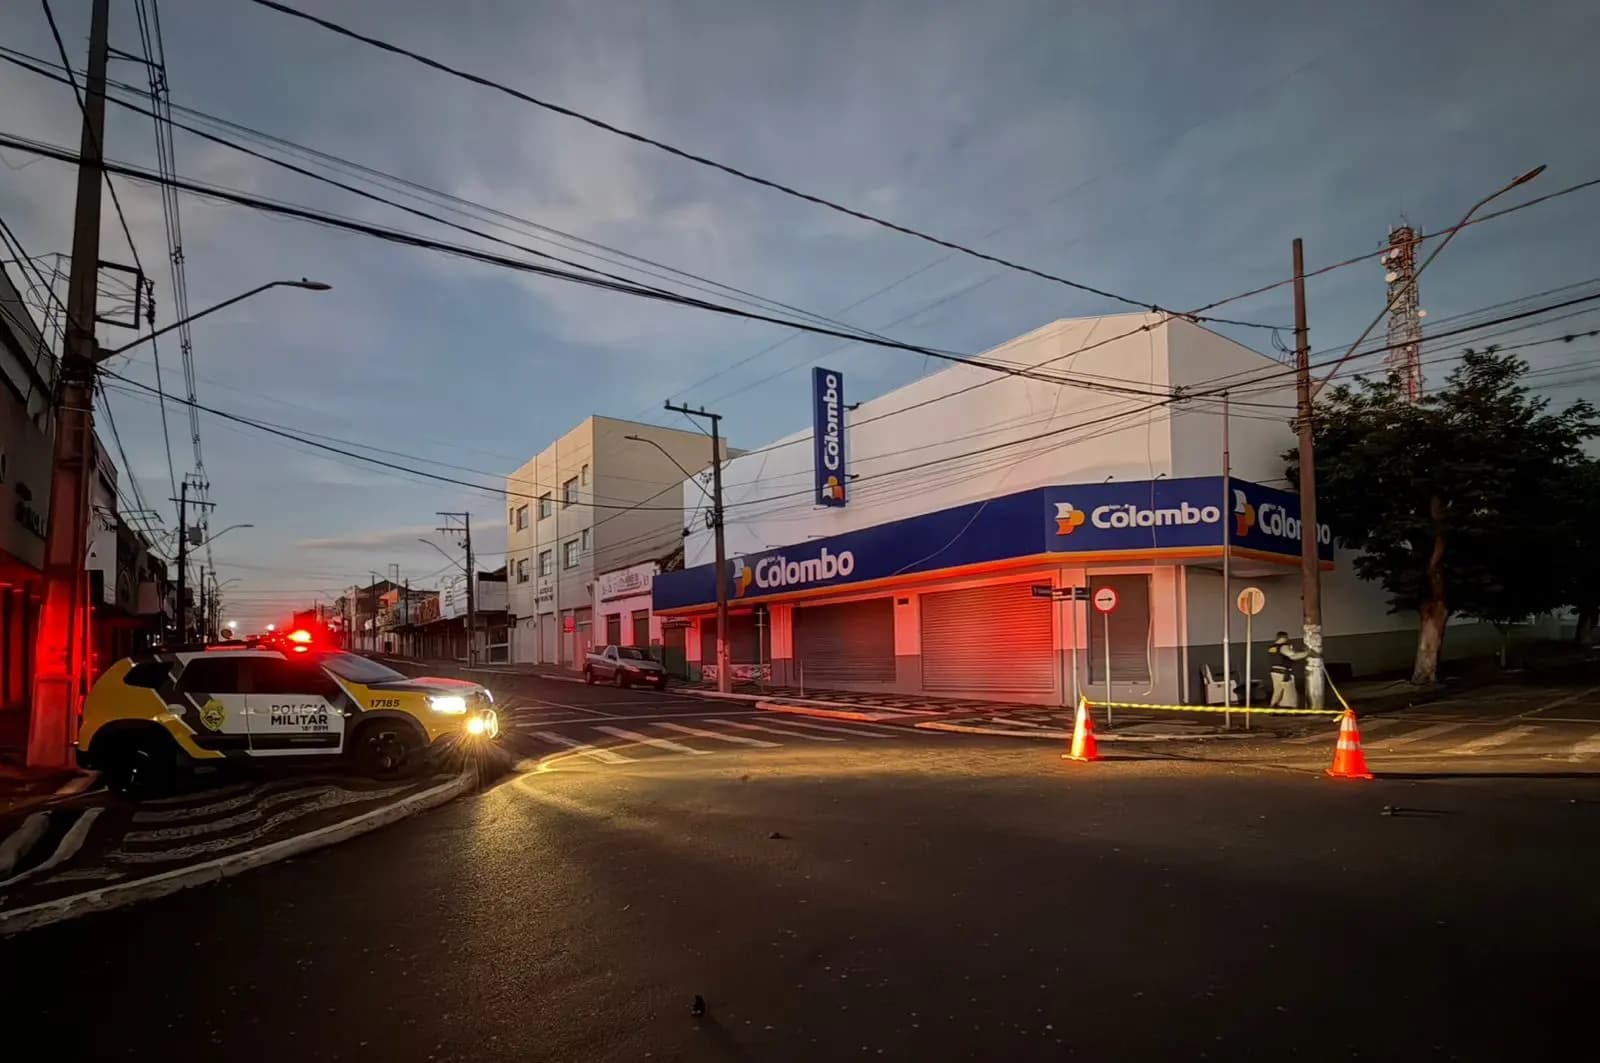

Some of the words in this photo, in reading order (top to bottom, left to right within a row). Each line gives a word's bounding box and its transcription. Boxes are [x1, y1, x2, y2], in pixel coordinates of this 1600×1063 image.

[823, 373, 840, 471] Colombo
[1091, 501, 1221, 529] Colombo
[755, 547, 855, 588] Colombo
[370, 699, 400, 708] 17185
[271, 715, 328, 725] MILITAR
